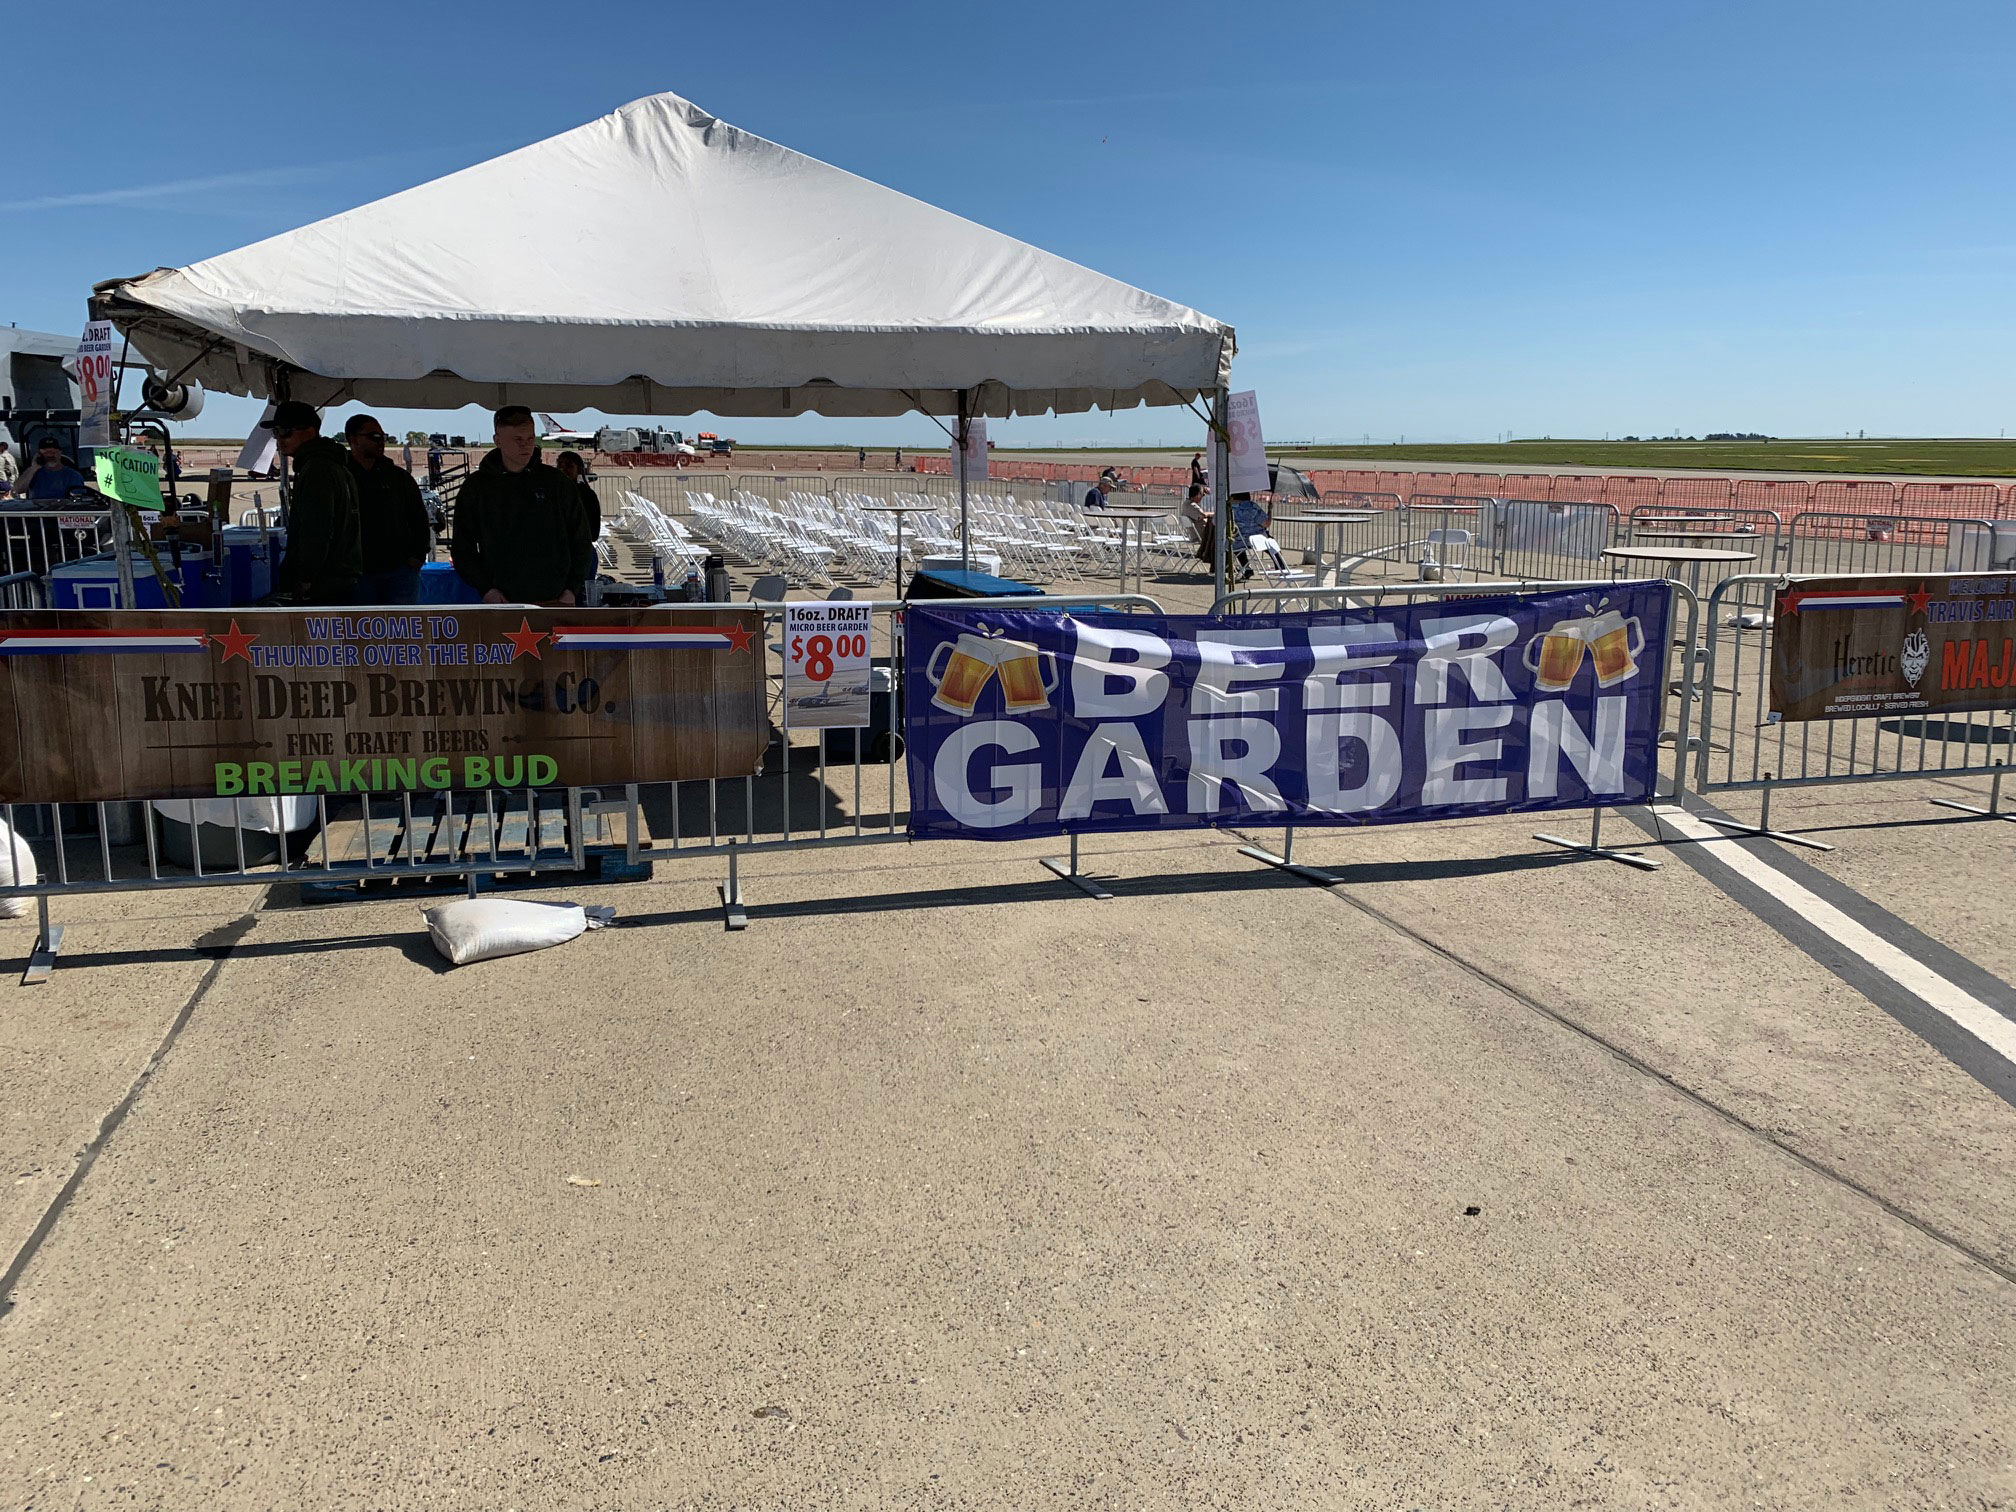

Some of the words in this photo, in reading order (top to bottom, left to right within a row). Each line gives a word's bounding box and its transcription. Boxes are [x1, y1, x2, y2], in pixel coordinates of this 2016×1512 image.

[89, 327, 111, 341] DRAFT
[1948, 578, 2007, 595] WELCOME
[789, 608, 824, 621] 16oz.
[828, 608, 869, 621] DRAFT
[1928, 600, 1984, 623] TRAVIS
[1986, 599, 2015, 621] AIR
[305, 616, 423, 639] WELCOME
[427, 616, 459, 639] TO
[789, 623, 815, 632] MICRO
[816, 623, 836, 632] BEER
[837, 623, 868, 631] GARDEN
[250, 645, 359, 668] THUNDER
[363, 644, 422, 666] OVER
[427, 643, 469, 665] THE
[474, 643, 516, 664] BAY
[1070, 614, 1520, 719] BEER
[1834, 635, 1895, 684] Heretic
[1941, 638, 2016, 690] MAJ
[1825, 704, 1851, 713] BREWED
[1852, 703, 1880, 711] LOCALLY
[1884, 701, 1908, 710] SERVED
[1909, 700, 1929, 708] FRESH
[1873, 693, 1892, 701] CRAFT
[286, 732, 334, 756] FINE
[344, 731, 412, 755] CRAFT
[422, 729, 489, 753] BEERS
[933, 696, 1628, 828] GARDEN
[215, 757, 450, 796] BREAKING
[464, 755, 558, 788] BUD
